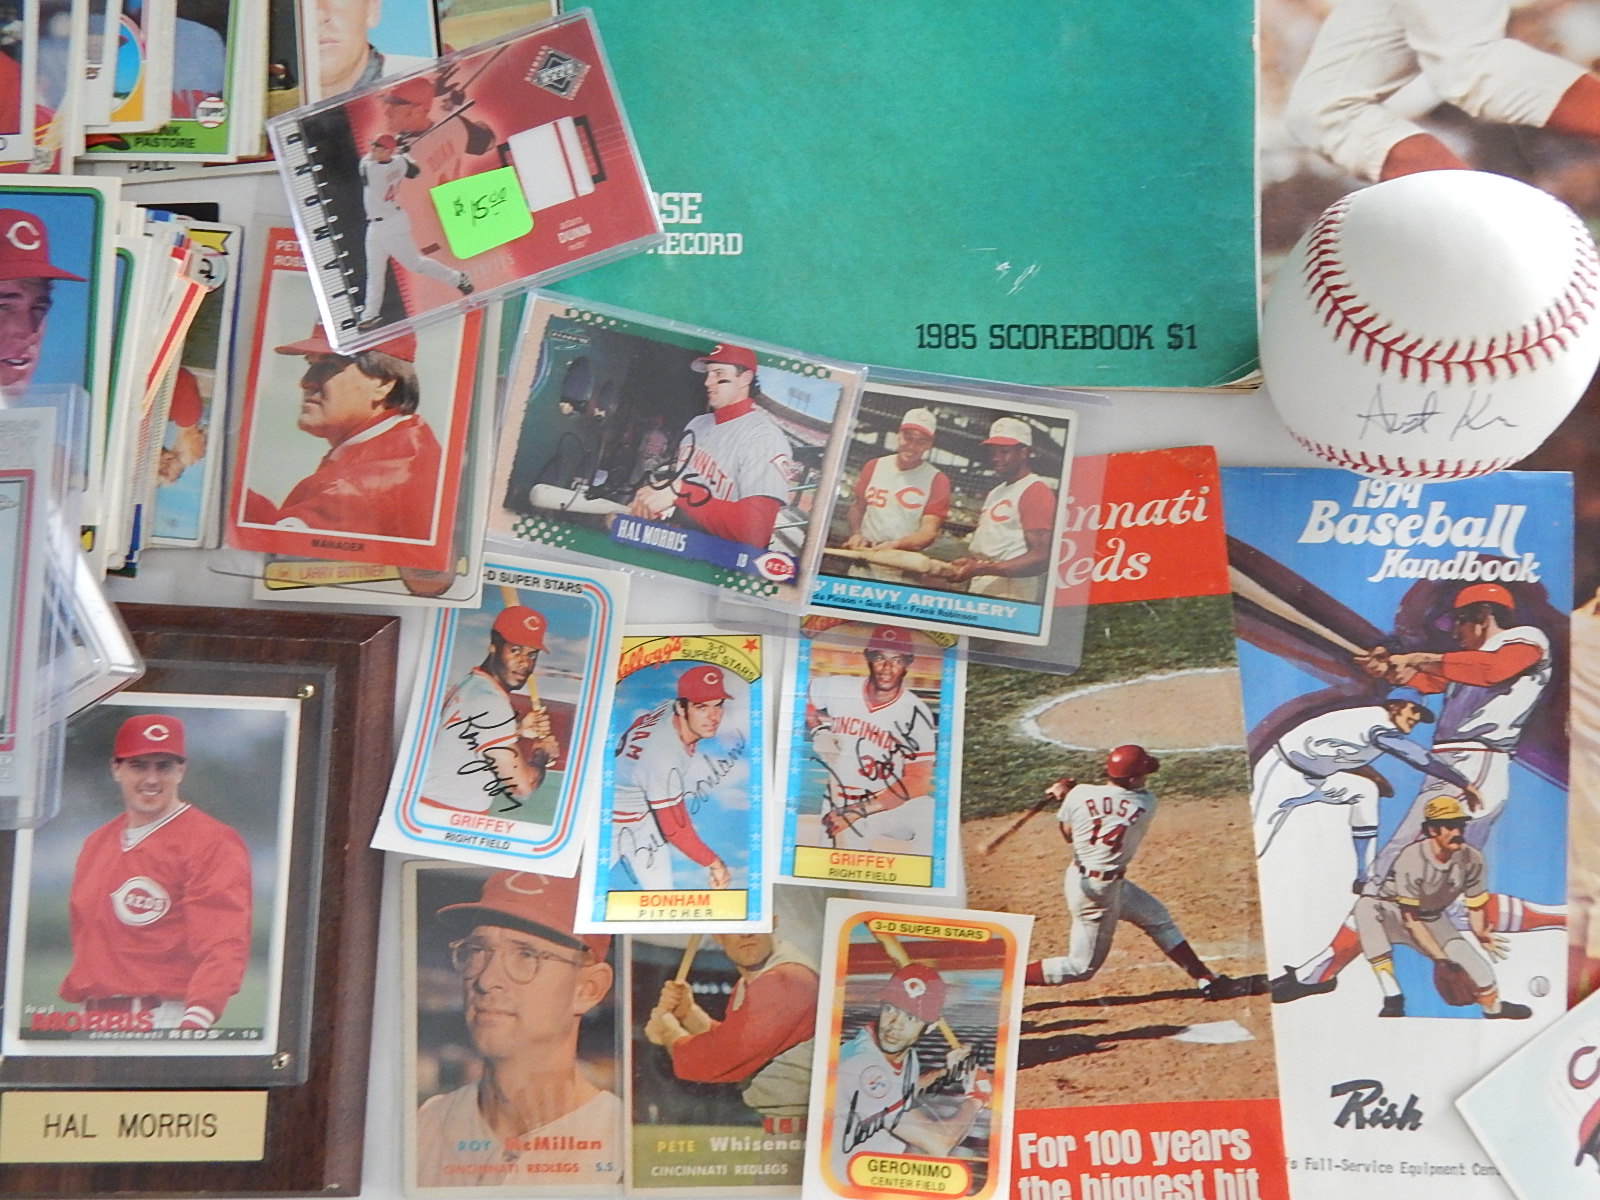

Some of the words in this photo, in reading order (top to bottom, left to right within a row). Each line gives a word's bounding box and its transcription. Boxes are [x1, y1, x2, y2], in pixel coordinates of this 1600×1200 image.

[134, 137, 196, 148] PASTORE
[647, 232, 743, 255] ECORD
[915, 323, 978, 349] 1985
[989, 323, 1155, 350] SCOREBOOK
[1167, 321, 1198, 351] $1
[1352, 477, 1424, 509] 1974
[617, 519, 642, 542] HAL
[641, 525, 688, 552] MORRIS
[1297, 500, 1528, 559] Baseball
[311, 538, 365, 551] MANAGER
[300, 566, 334, 579] LARRY
[766, 561, 796, 579] REDS
[1367, 548, 1542, 585] Handbook
[483, 570, 496, 581] -D
[499, 572, 540, 588] SUPER
[543, 578, 584, 594] STARS
[832, 582, 902, 603] HEAVY
[906, 592, 1019, 620] ARTILLERY
[865, 598, 883, 609] Gus
[909, 604, 936, 616] Frank
[937, 608, 979, 622] Robinson
[708, 641, 727, 655] 3-D
[680, 648, 718, 661] SUPER
[720, 655, 756, 682] STARS
[1085, 797, 1147, 827] ROSE
[449, 813, 517, 834] GRIFFEY
[444, 831, 478, 845] RIGHT
[480, 837, 511, 850] FIELD
[1089, 817, 1128, 853] 14
[828, 852, 897, 869] GRIFFEY
[828, 867, 866, 881] RIGHT
[867, 870, 898, 883] FIELD
[125, 893, 167, 912] REDS
[639, 894, 711, 908] BONHAM
[638, 908, 714, 919] PITCHER
[874, 920, 897, 933] 3-D
[900, 922, 942, 937] SUPER
[944, 928, 985, 941] STARS
[32, 1009, 154, 1032] MORRIS
[168, 1029, 223, 1040] REDS
[1330, 1078, 1424, 1132] Rish
[43, 1112, 98, 1140] HAL
[118, 1111, 219, 1139] MORRIS
[458, 1139, 492, 1152] ROY
[504, 1136, 603, 1151] McMillan
[656, 1140, 697, 1153] PETE
[709, 1136, 807, 1152] Whisena
[1017, 1131, 1078, 1170] For
[1084, 1128, 1143, 1166] 100
[1149, 1127, 1252, 1166] years
[444, 1162, 519, 1176] CINCINNATI
[527, 1161, 581, 1175] REDLEGS
[651, 1163, 728, 1178] CINCINNATI
[734, 1162, 790, 1176] REDLEGS
[867, 1158, 953, 1180] GERONIMO
[1304, 1156, 1395, 1174] Full-Service
[1400, 1161, 1466, 1177] Equipment
[870, 1175, 914, 1189] CENTER
[915, 1180, 947, 1193] FIELD
[1017, 1174, 1072, 1200] the
[1080, 1169, 1205, 1200] biggest
[1213, 1167, 1260, 1200] hit
